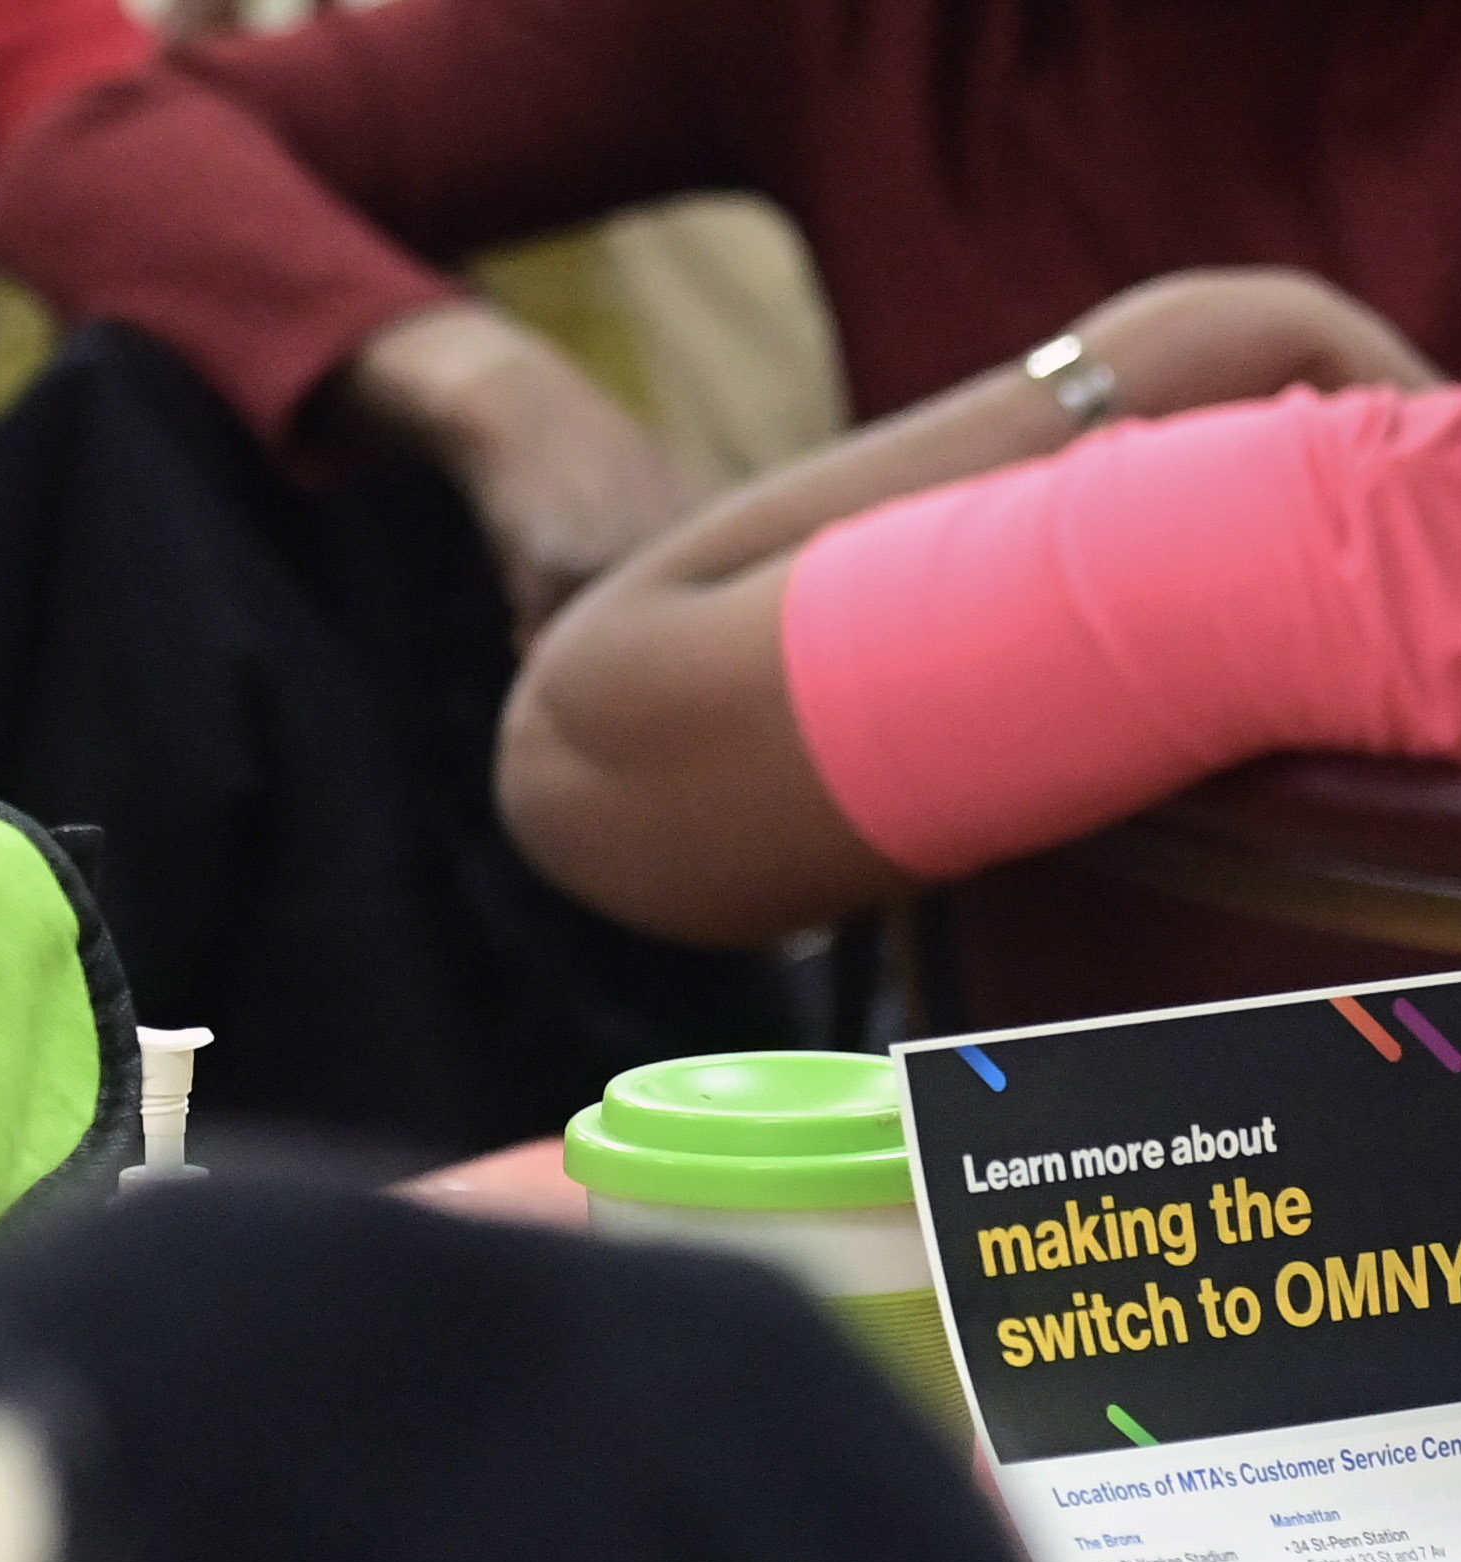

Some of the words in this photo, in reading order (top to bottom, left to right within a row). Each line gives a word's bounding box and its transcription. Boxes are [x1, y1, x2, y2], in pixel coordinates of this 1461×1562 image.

[962, 1152, 1068, 1194] Learn
[1071, 1132, 1165, 1179] more
[1170, 1116, 1278, 1166] about
[977, 1193, 1196, 1277] making
[1208, 1177, 1312, 1246] the
[997, 1278, 1189, 1368] switch
[1198, 1277, 1262, 1339] to
[1052, 1481, 1151, 1508] Locations
[1155, 1474, 1175, 1496] of
[1177, 1467, 1237, 1493] MTA's
[1239, 1457, 1336, 1485] Customer
[1340, 1444, 1417, 1471] Service
[1270, 1509, 1341, 1528] Manhattan
[1074, 1536, 1101, 1552] The
[1102, 1533, 1144, 1548] Bronx
[1291, 1539, 1309, 1554] 34
[1311, 1533, 1362, 1553] St-Penn
[1363, 1529, 1410, 1545] Station
[1396, 1548, 1419, 1562] and
[1418, 1547, 1428, 1559] 7
[1430, 1545, 1447, 1558] Av
